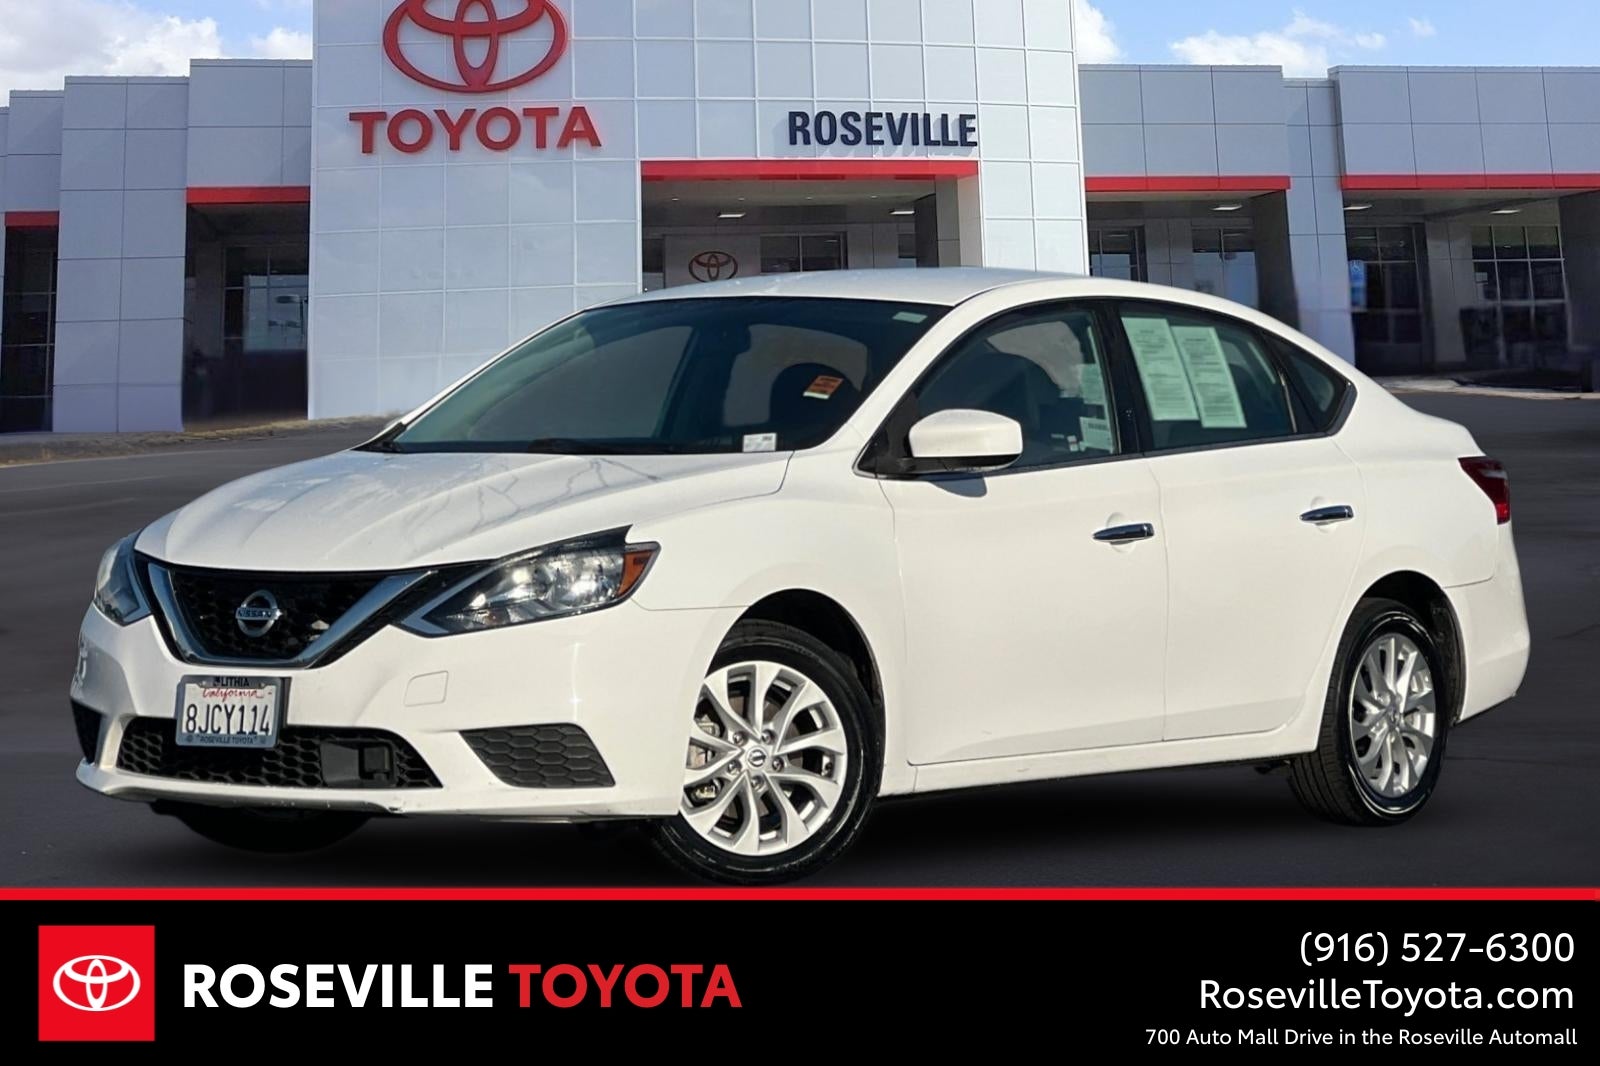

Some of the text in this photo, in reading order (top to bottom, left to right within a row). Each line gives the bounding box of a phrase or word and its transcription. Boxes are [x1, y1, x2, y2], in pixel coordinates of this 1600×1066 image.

[349, 106, 602, 154] TOYOTA
[788, 111, 978, 147] ROSEVILLE
[220, 676, 250, 687] LITHIA
[186, 703, 270, 735] 8JCY114
